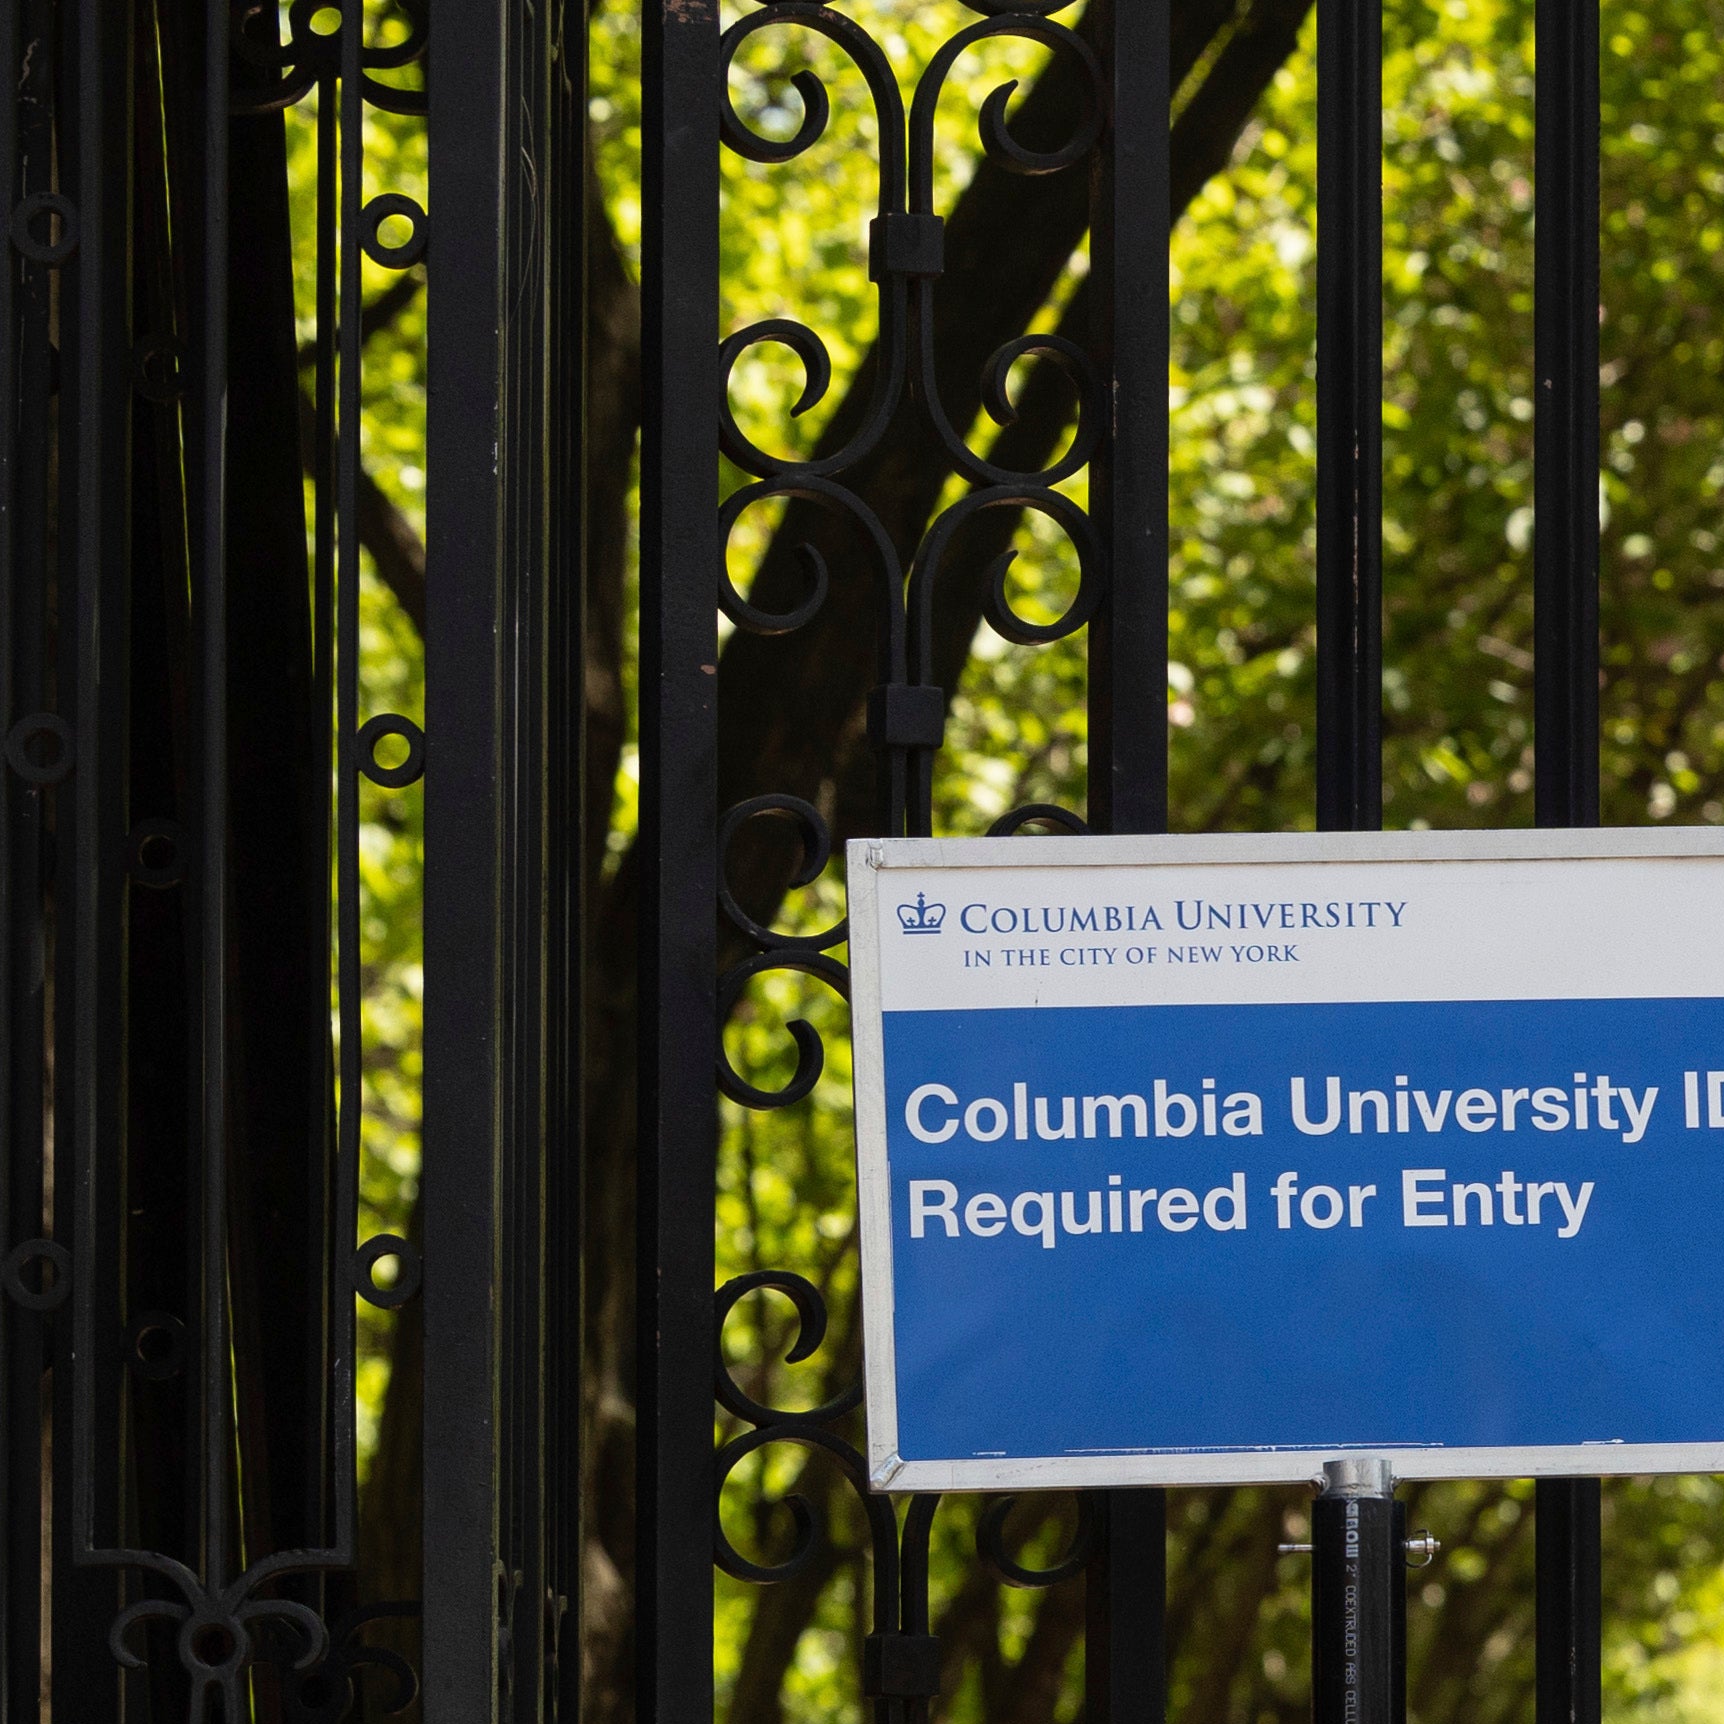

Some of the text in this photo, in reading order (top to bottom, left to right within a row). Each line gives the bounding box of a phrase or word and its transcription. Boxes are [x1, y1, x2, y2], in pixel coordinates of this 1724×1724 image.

[960, 899, 1407, 934] COLUMBIA UNIVERSITY
[964, 944, 1300, 968] IN THE CITY OF NEW YORK
[904, 1078, 1263, 1143] Columbia
[1290, 1073, 1659, 1143] University
[909, 1169, 1595, 1249] Required for Entry
[1344, 1585, 1357, 1656] COEXTRUDED
